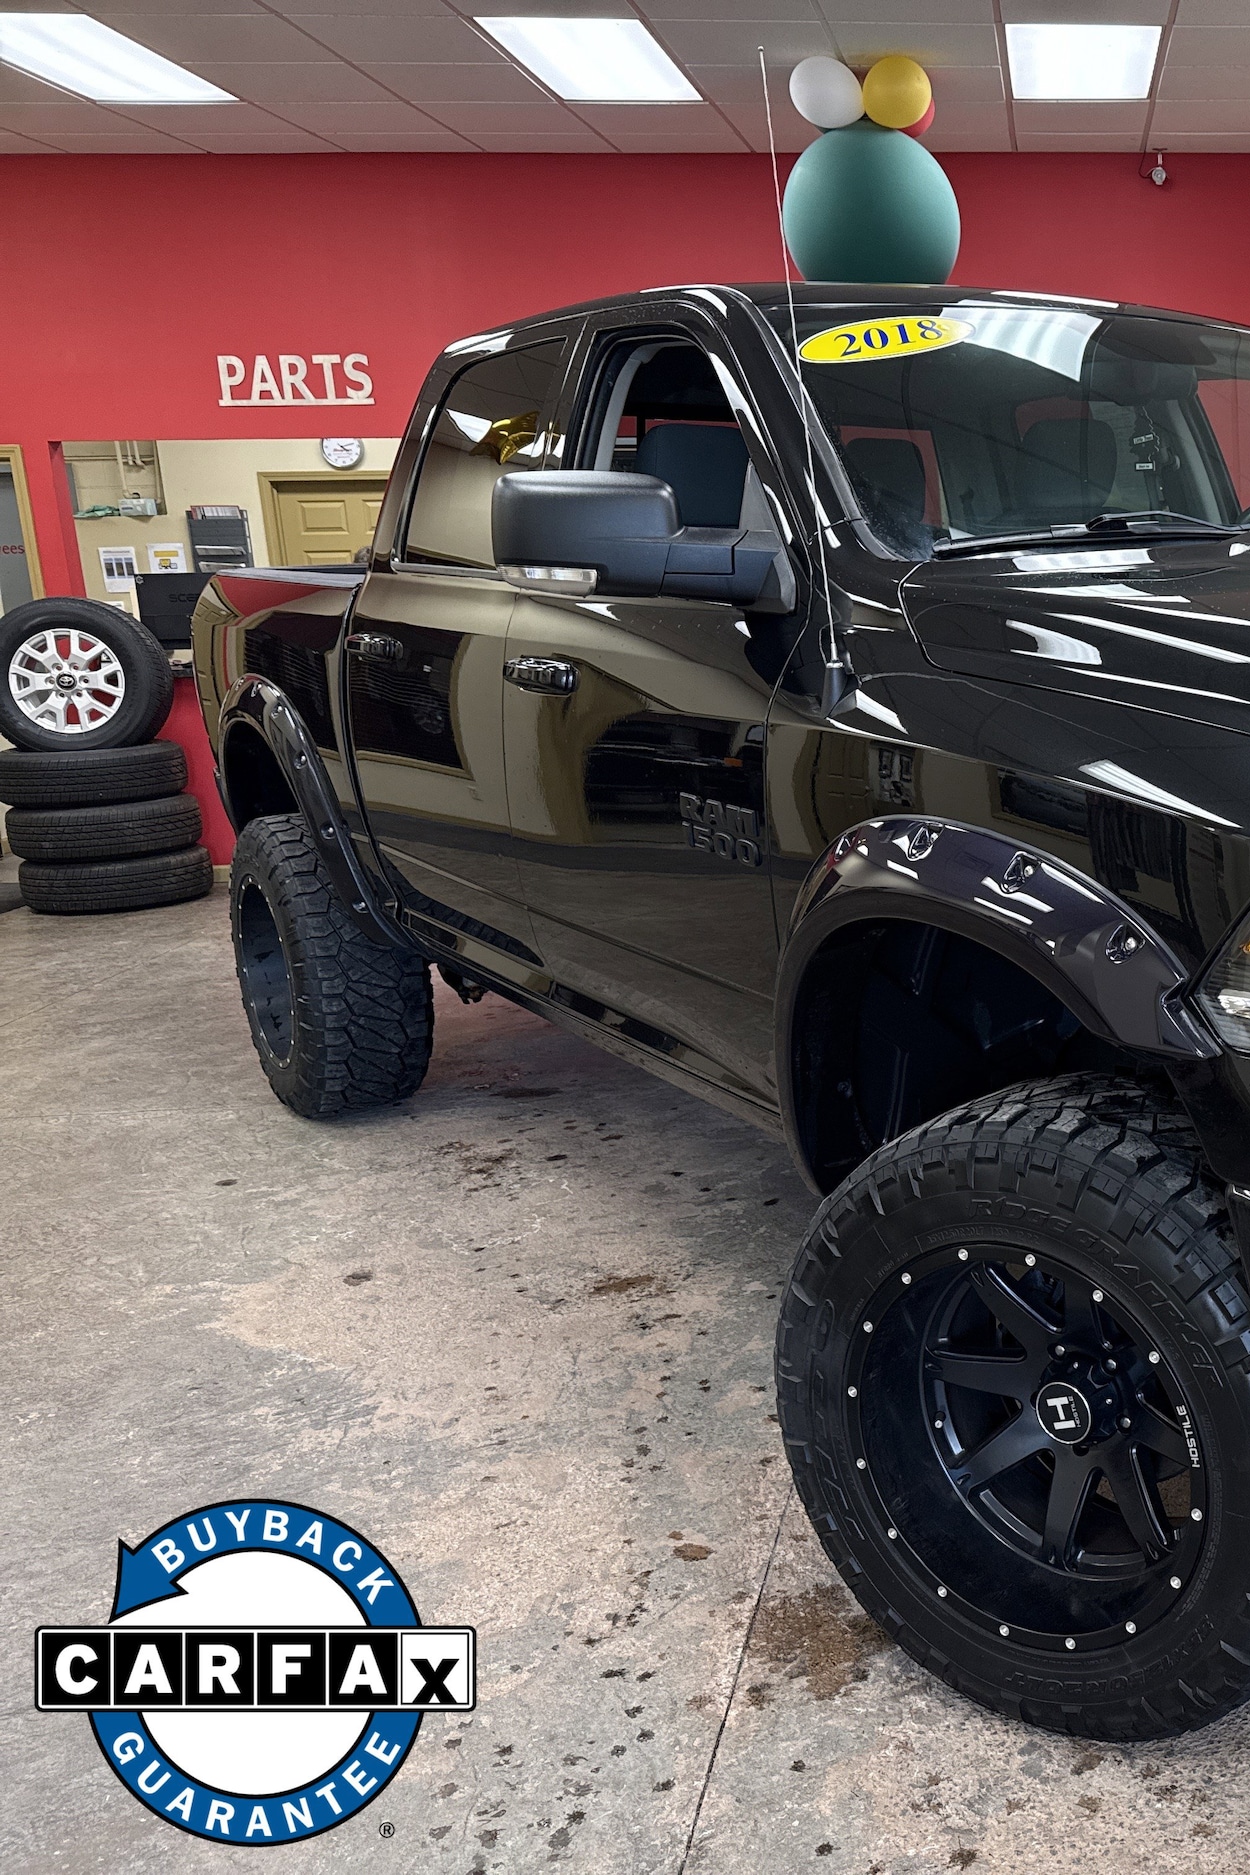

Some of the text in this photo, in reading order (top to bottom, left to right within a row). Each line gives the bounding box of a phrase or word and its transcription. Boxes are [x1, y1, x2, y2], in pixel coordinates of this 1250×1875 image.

[833, 319, 944, 358] 2018
[217, 353, 374, 401] PARTS
[0, 545, 25, 555] ees
[169, 593, 200, 603] SCE
[680, 791, 760, 838] RAM
[681, 821, 764, 868] 1500
[1068, 1395, 1082, 1428] HOSTILE
[1175, 1404, 1201, 1468] HOSTILE
